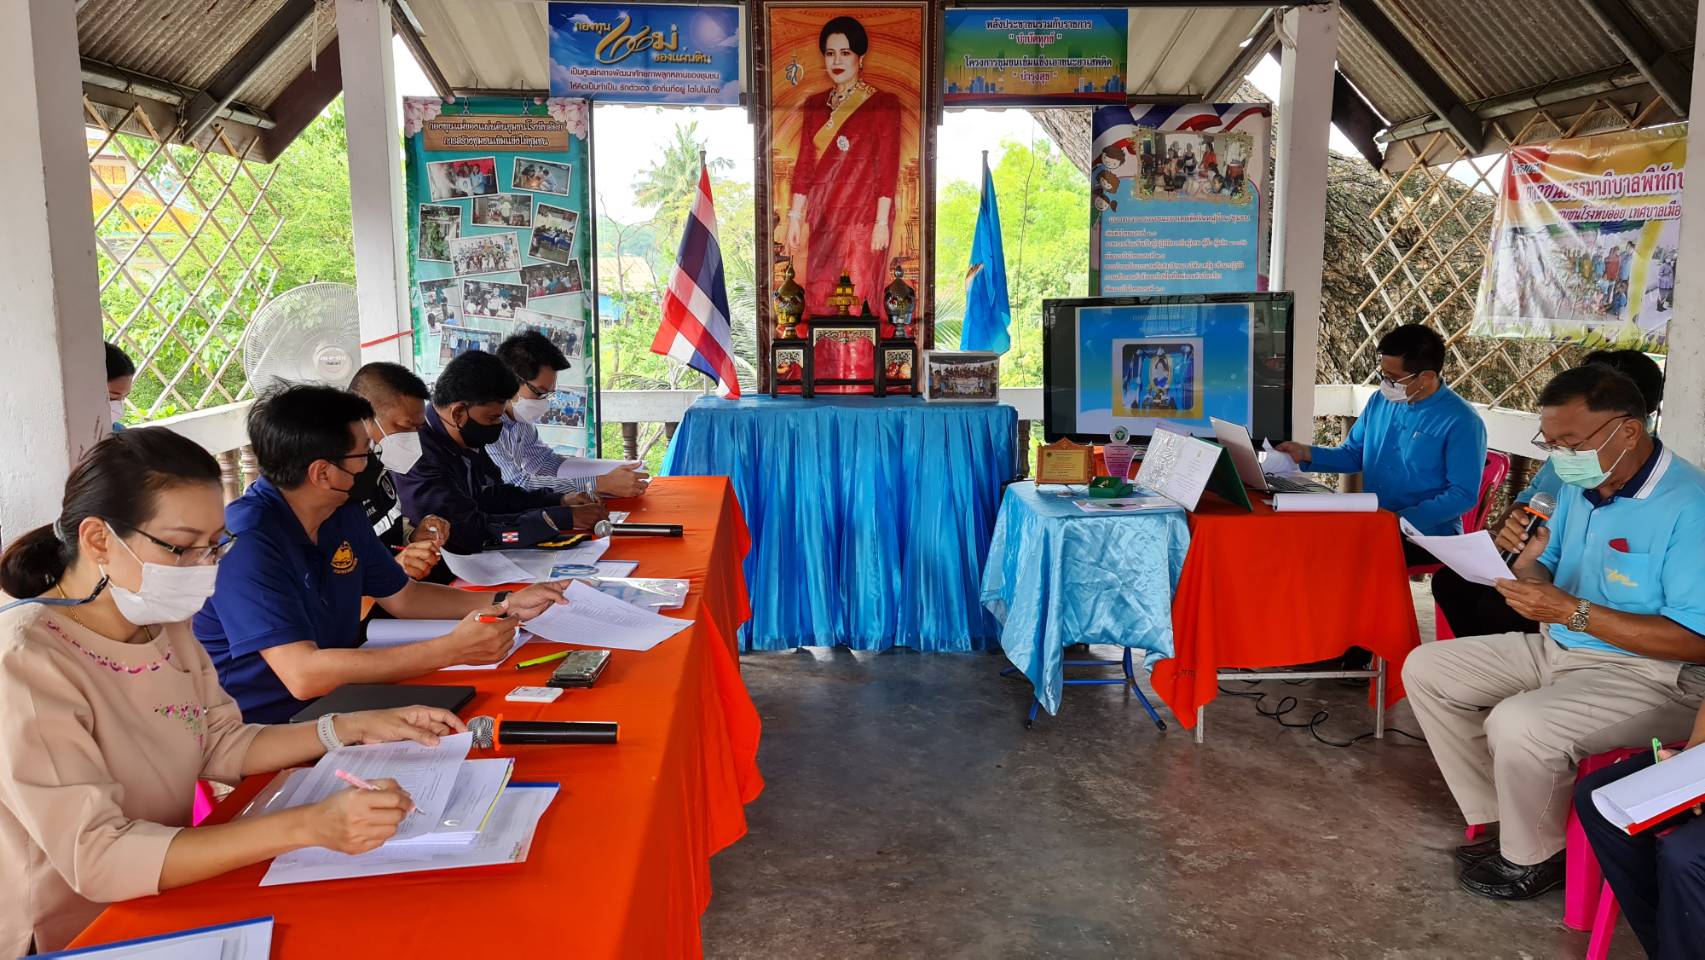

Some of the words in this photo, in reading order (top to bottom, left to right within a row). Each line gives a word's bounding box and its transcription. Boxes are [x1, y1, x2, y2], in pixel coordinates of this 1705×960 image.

[576, 22, 612, 35] กองทุน
[654, 50, 712, 64] ของแผ่นดิน
[1628, 200, 1681, 219] เทศบาลเมือ
